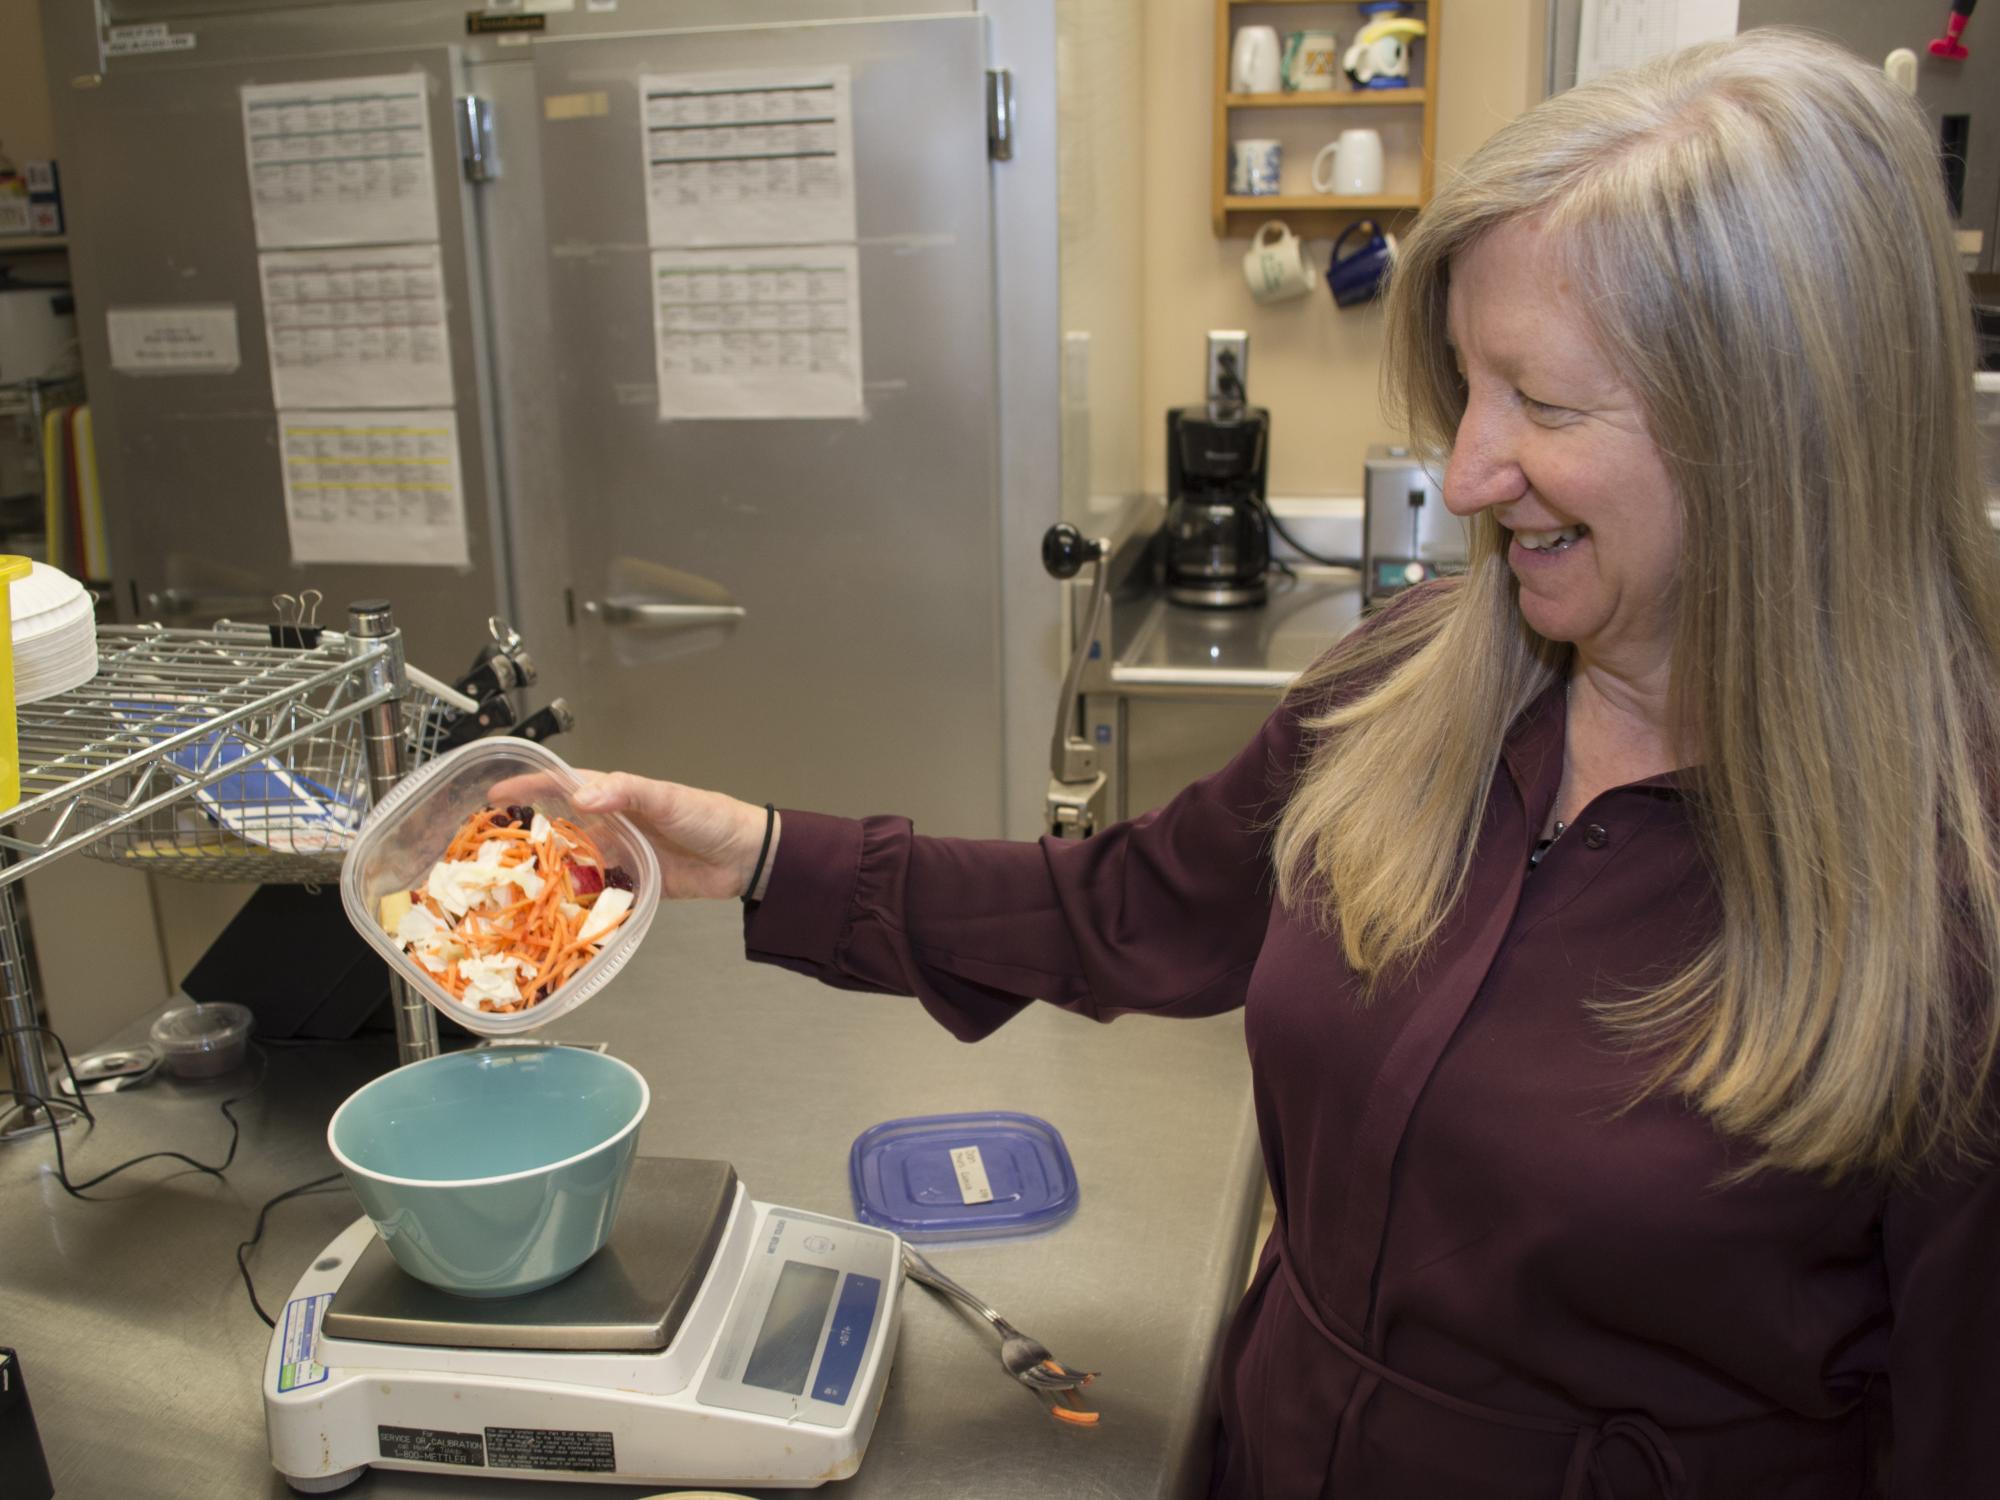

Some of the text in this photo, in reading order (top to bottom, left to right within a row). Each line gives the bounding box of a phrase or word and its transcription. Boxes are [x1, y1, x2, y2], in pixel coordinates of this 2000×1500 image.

[381, 1432, 411, 1444] SERVICE
[415, 1436, 427, 1444] OR
[431, 1438, 483, 1450] CALIBRATION
[394, 1449, 467, 1463] 1-800-METTLER
